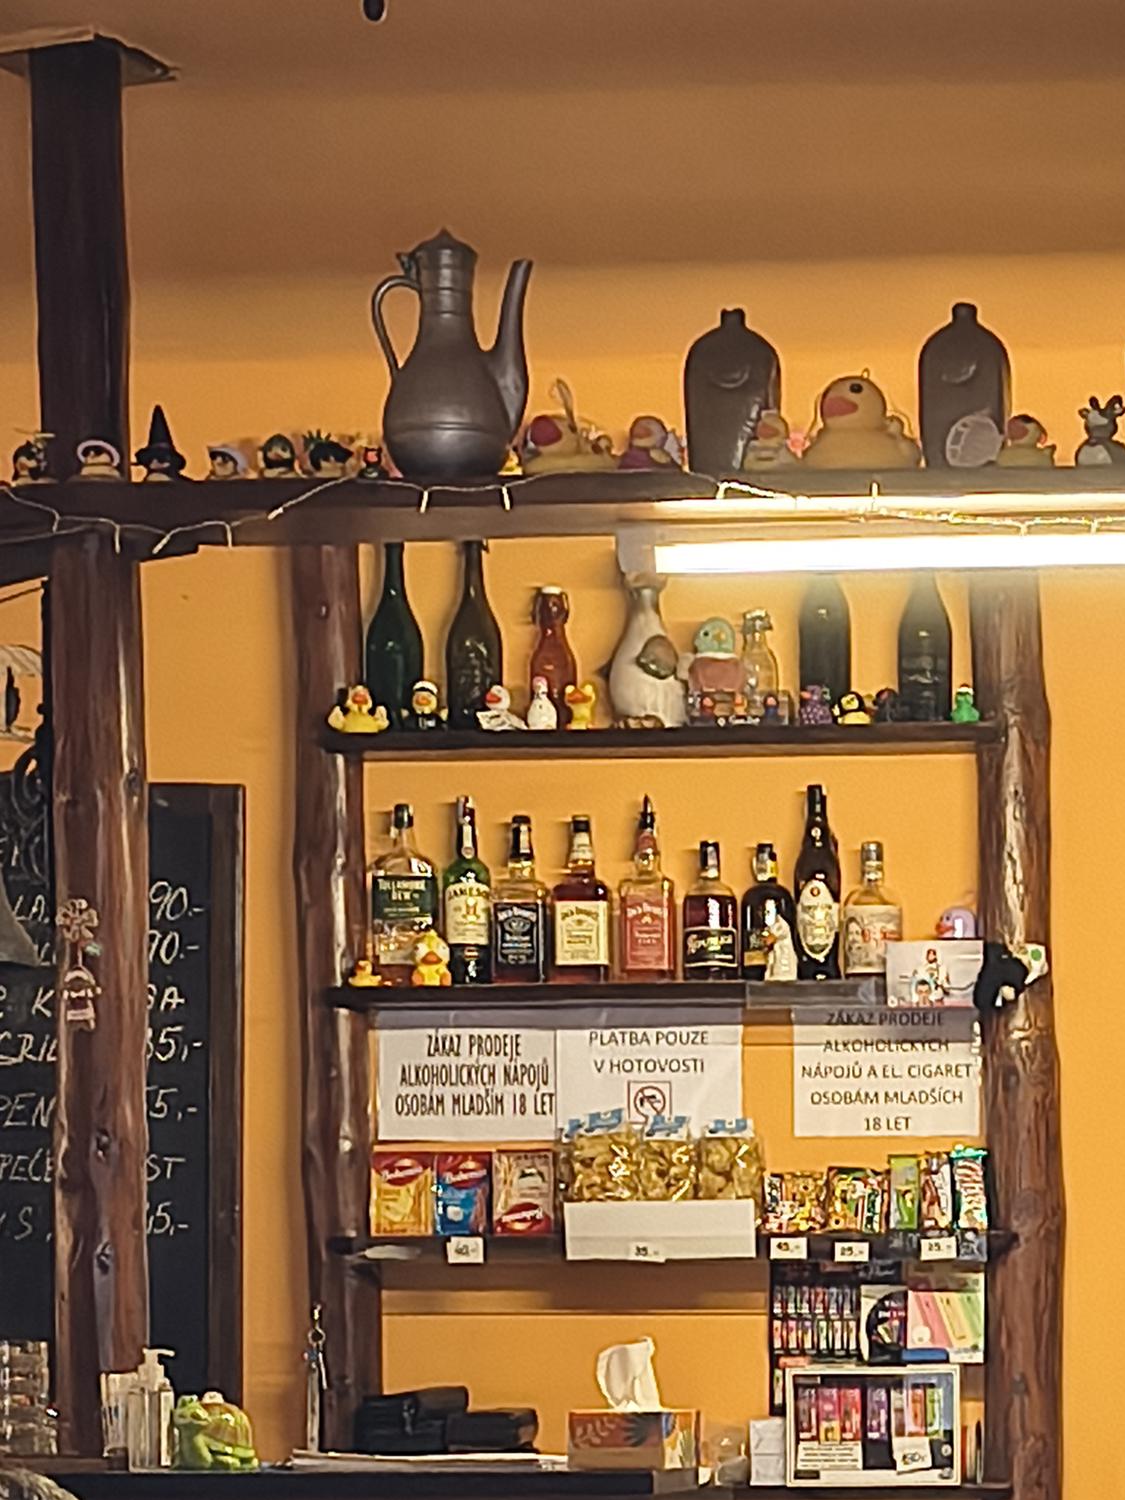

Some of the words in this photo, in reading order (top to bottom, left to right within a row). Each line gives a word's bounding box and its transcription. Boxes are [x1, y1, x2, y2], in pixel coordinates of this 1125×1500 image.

[827, 1010, 875, 1026] ZÁKAZ
[879, 1012, 944, 1027] PRODEJE
[427, 1030, 461, 1057] ZÁKAZ
[469, 1033, 522, 1062] PRODEJE
[589, 1030, 651, 1046] PLATBA
[656, 1031, 709, 1046] POUZE
[400, 1059, 496, 1087] ALKOHOLICKÝCH
[503, 1058, 549, 1092] NÁPOJŮ
[594, 1060, 604, 1073] V
[610, 1059, 705, 1073] HOTOVOSTI
[801, 1061, 862, 1079] NÁPOJŮ
[867, 1066, 878, 1078] A
[907, 1063, 973, 1078] CIGARET
[395, 1088, 445, 1116] OSOBÁM
[452, 1088, 504, 1116] MLADŠÍM
[513, 1094, 527, 1116] 18
[534, 1093, 555, 1116] LET
[811, 1088, 879, 1105] OSOBÁM
[884, 1086, 963, 1105] MLADŠÍCH
[865, 1117, 881, 1131] 18
[886, 1117, 912, 1131] LET
